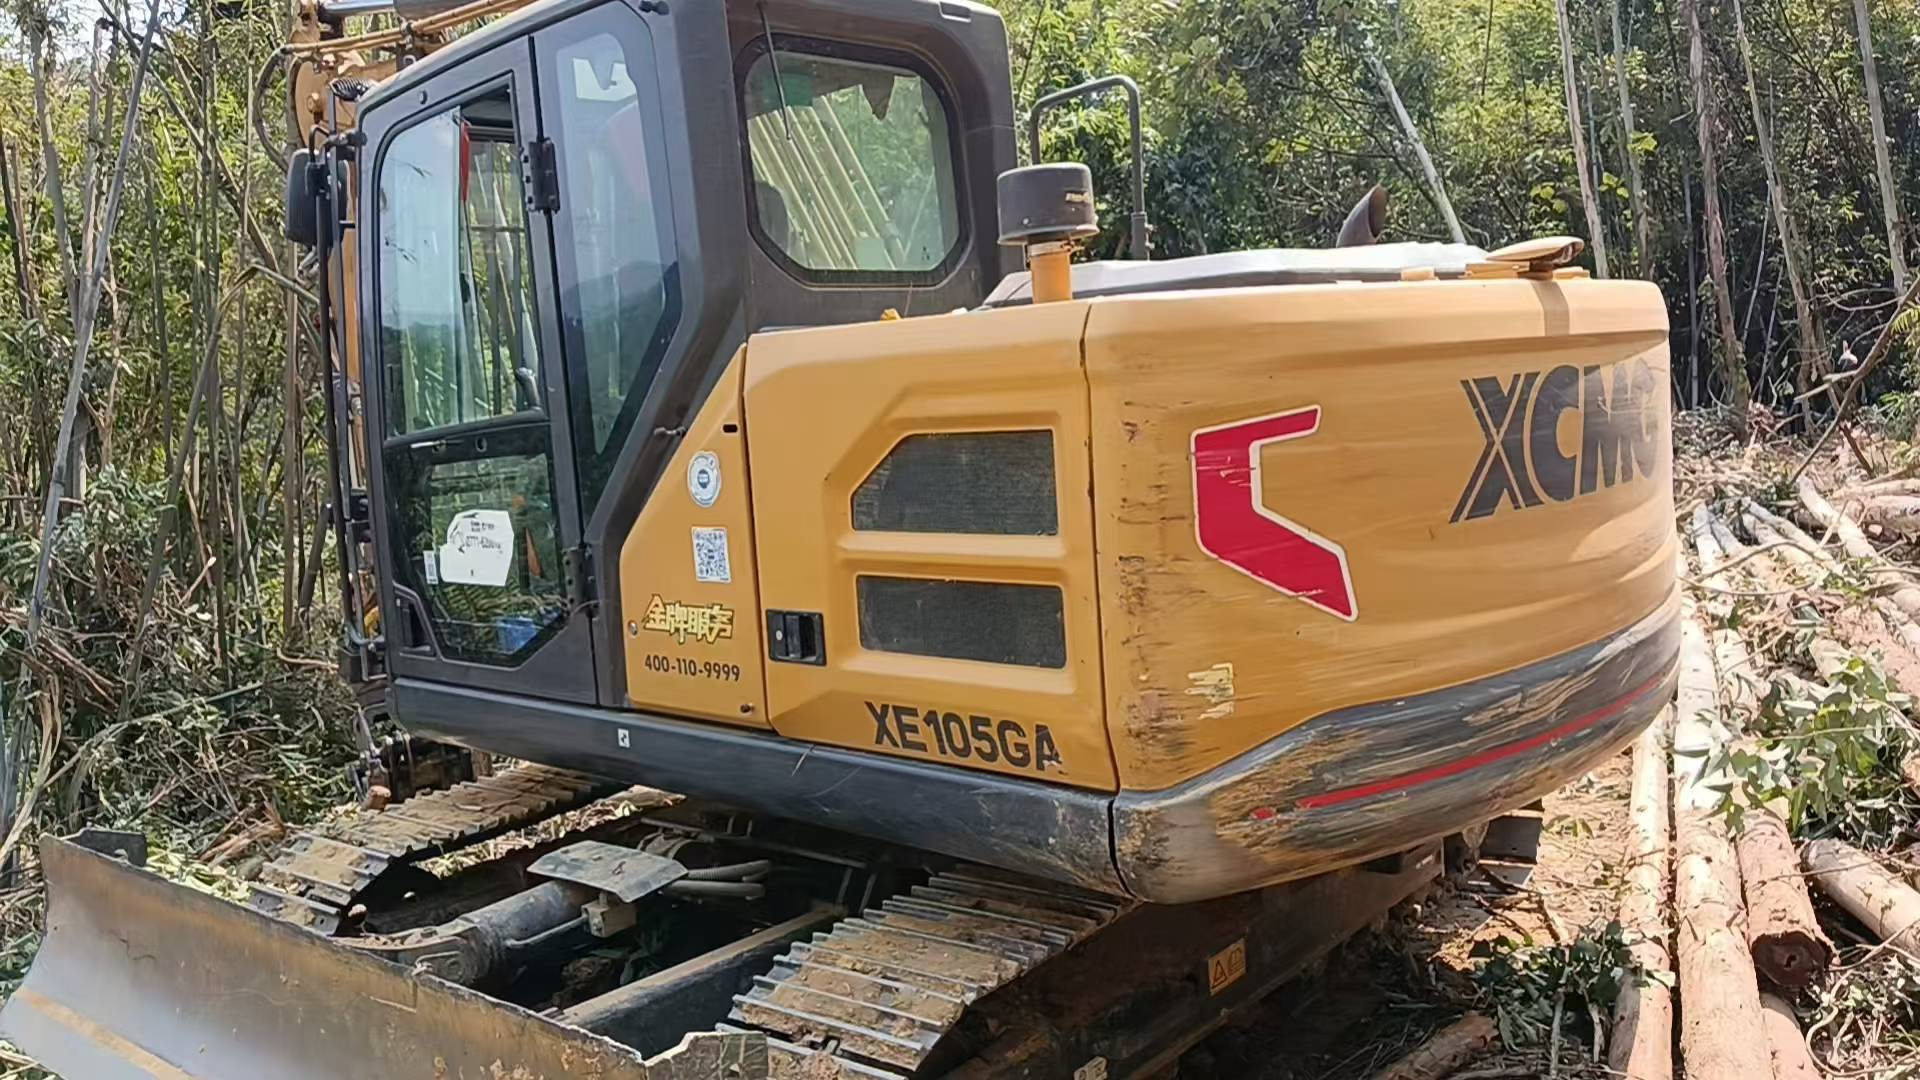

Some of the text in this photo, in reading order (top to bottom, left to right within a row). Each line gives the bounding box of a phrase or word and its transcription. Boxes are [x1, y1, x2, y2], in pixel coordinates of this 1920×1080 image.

[642, 593, 734, 645] 金牌服务
[644, 653, 740, 682] 400-110-9999
[864, 700, 1064, 775] XE105GA
